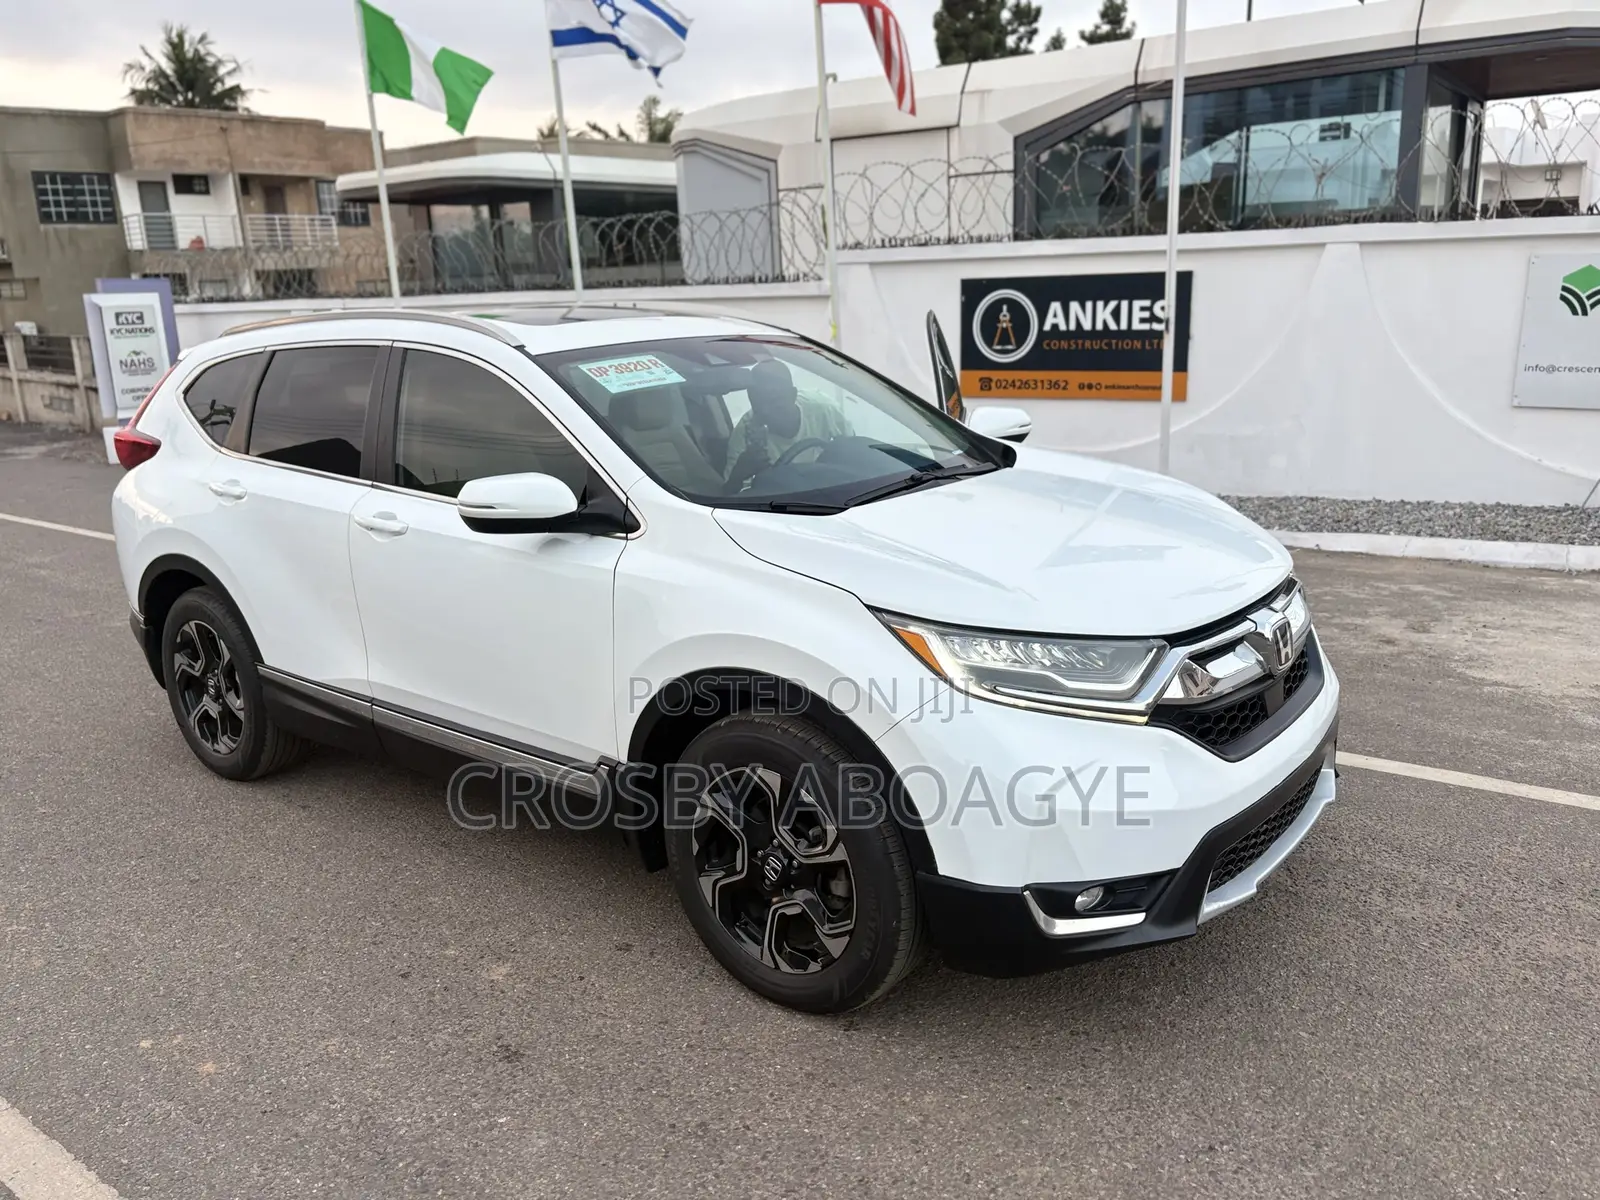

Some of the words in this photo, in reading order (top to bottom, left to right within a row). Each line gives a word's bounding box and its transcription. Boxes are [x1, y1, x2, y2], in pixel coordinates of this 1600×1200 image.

[1043, 299, 1168, 332] ANKIES
[1043, 338, 1141, 350] CONSTRUCTION
[119, 357, 155, 368] NAHS
[995, 378, 1069, 391] 0242631362
